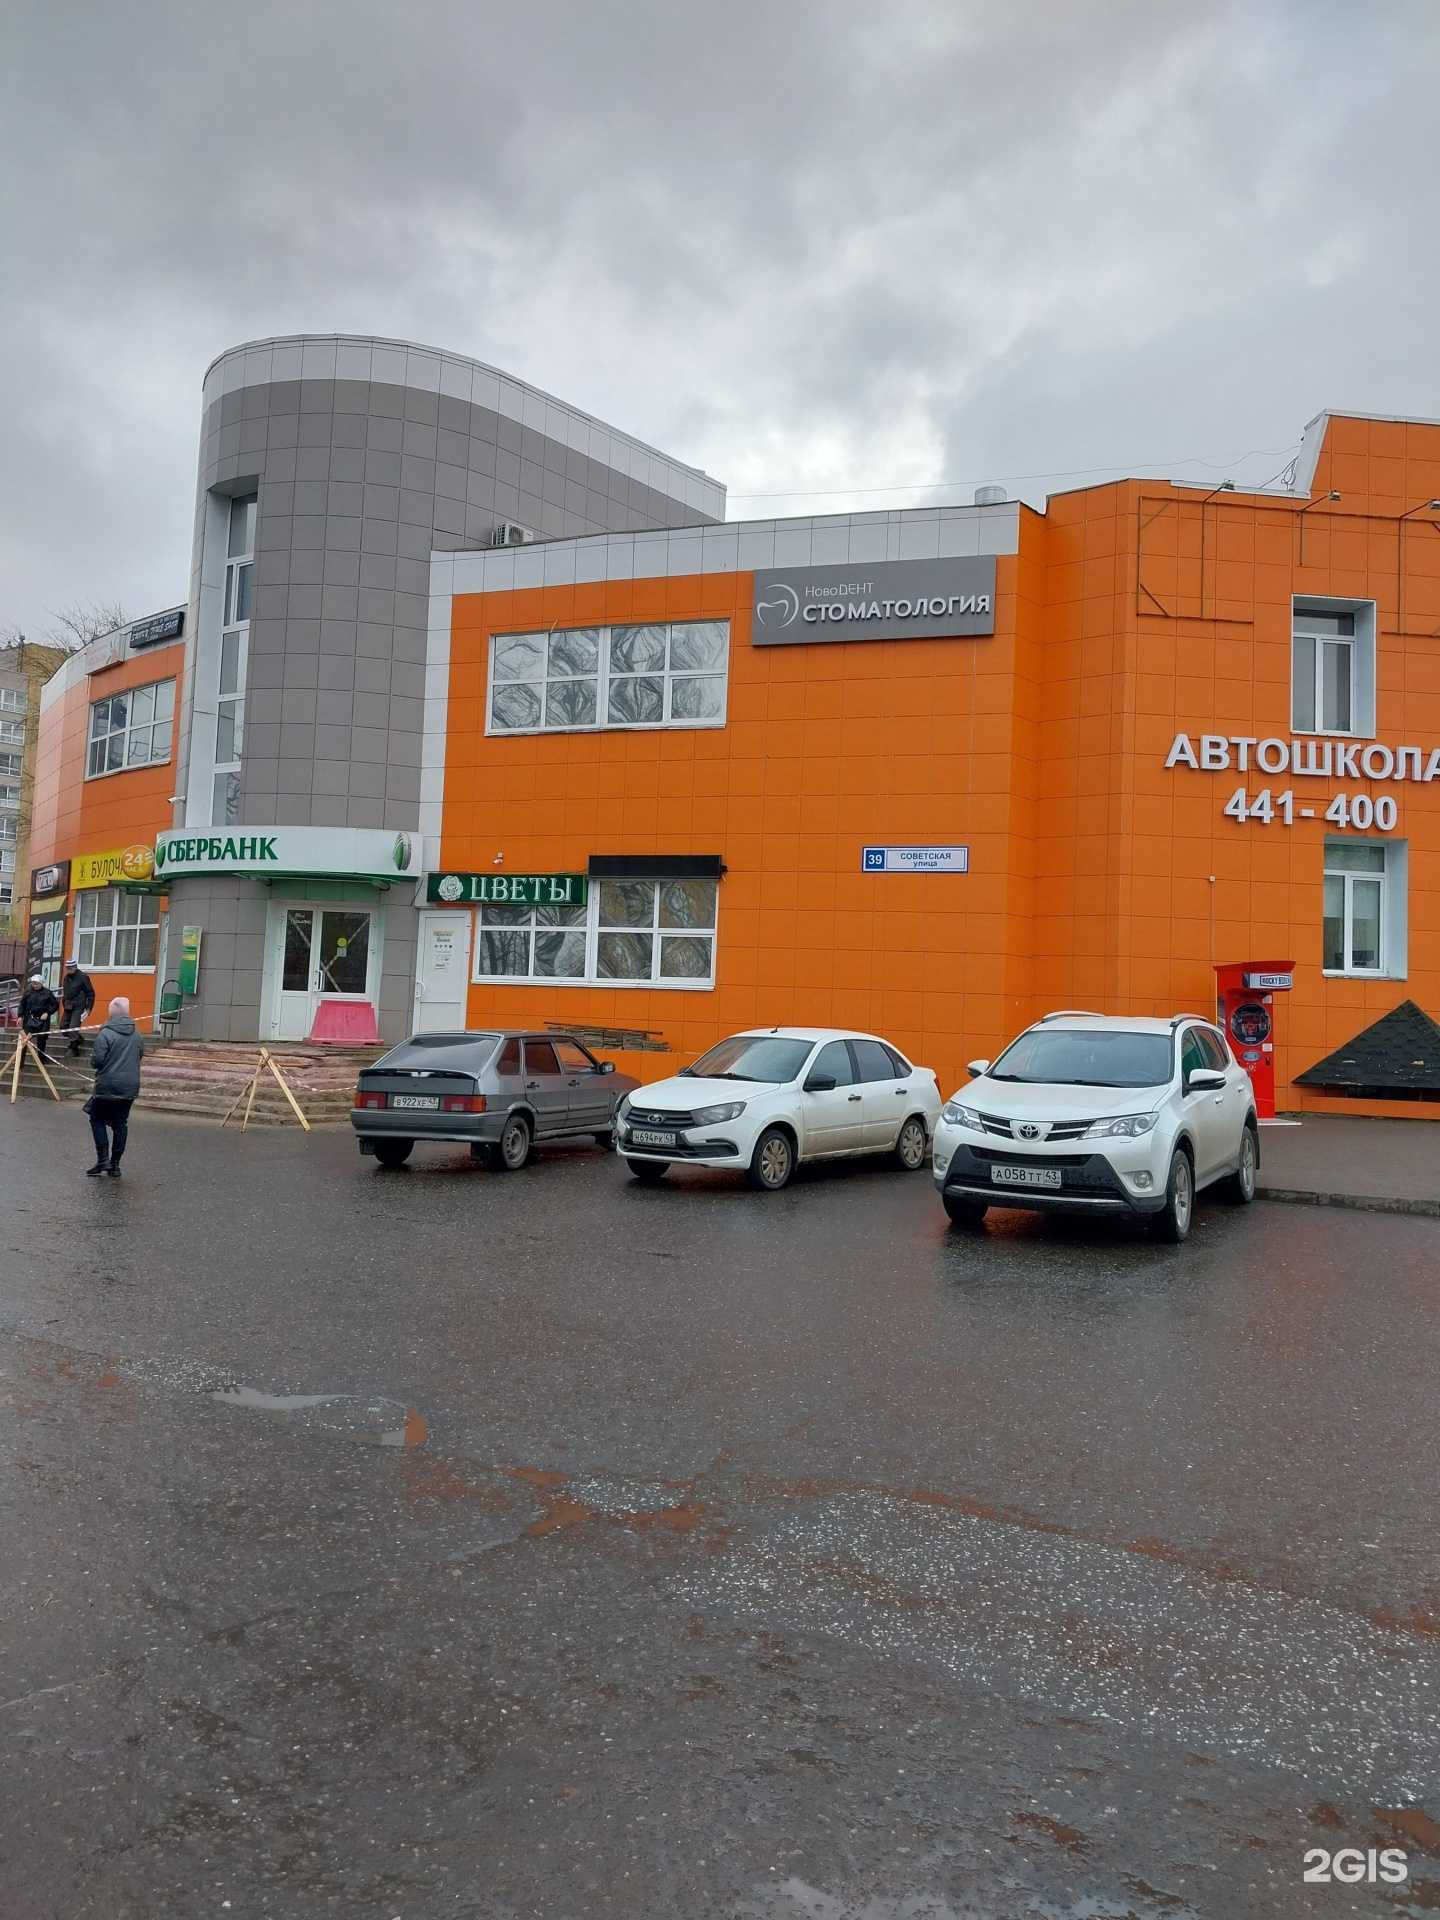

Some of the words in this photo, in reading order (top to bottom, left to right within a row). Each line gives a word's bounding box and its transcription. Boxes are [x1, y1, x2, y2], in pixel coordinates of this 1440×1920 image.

[803, 595, 991, 623] СТОМАТОЛОГИЯ
[124, 852, 143, 866] 24
[167, 837, 279, 863] СБЕРБАНК
[900, 852, 952, 860] СОВЕТСКАЯ
[91, 857, 123, 879] БУЛОЧ
[868, 854, 883, 865] 39
[913, 860, 938, 868] улица
[470, 876, 573, 902] ЦВЕТЫ
